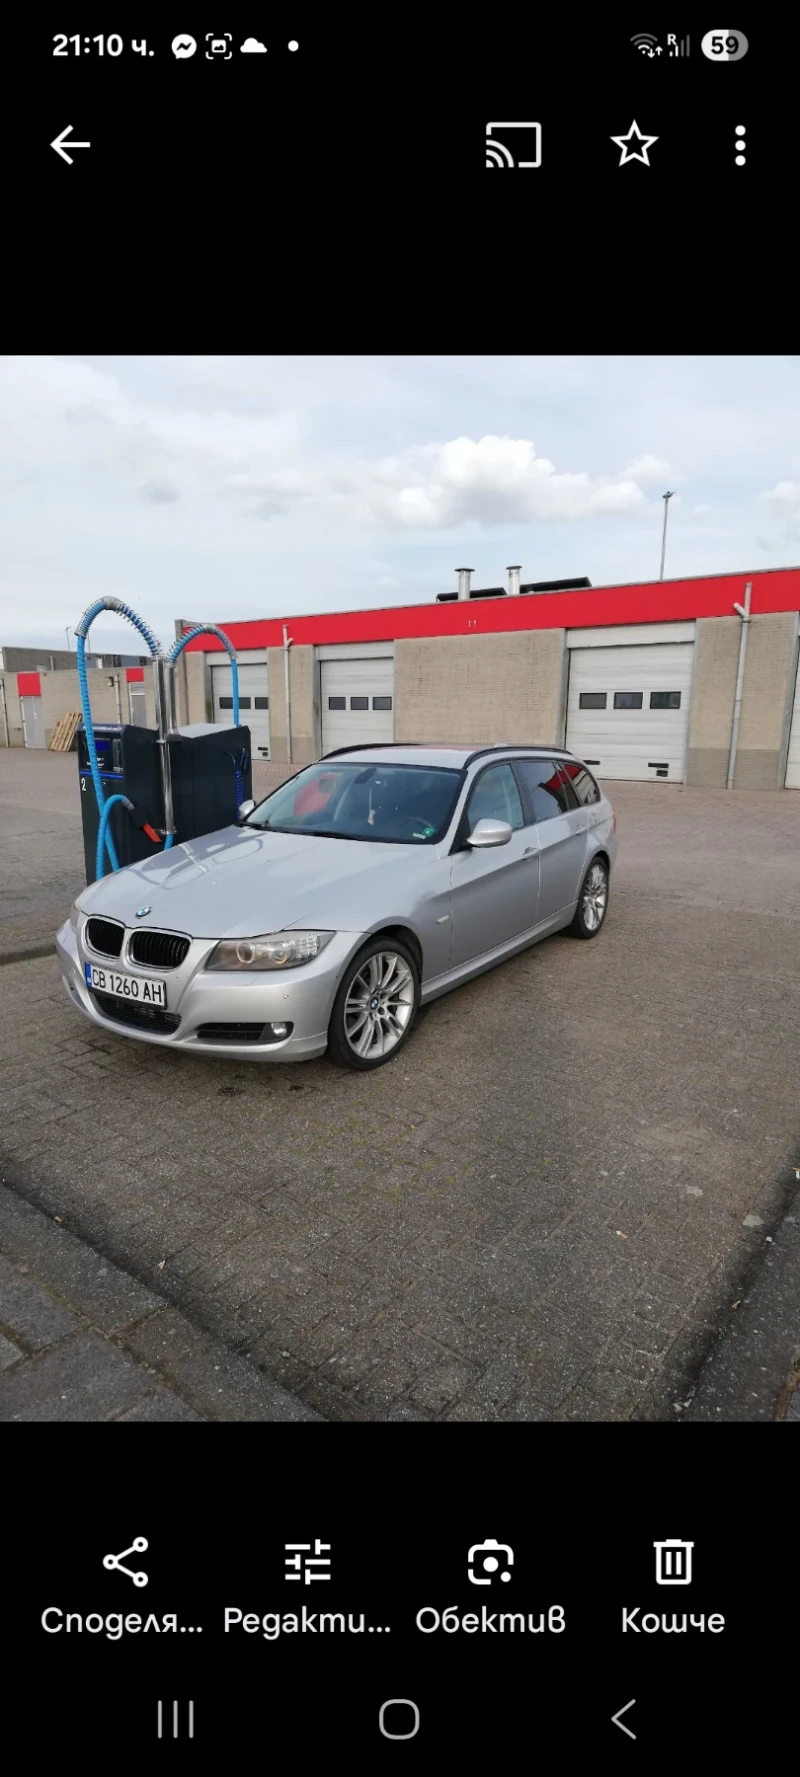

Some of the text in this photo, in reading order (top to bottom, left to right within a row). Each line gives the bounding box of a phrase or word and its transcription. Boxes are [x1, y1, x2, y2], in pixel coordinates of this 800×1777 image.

[81, 777, 87, 792] 2
[92, 969, 162, 1003] CB 1260 AH
